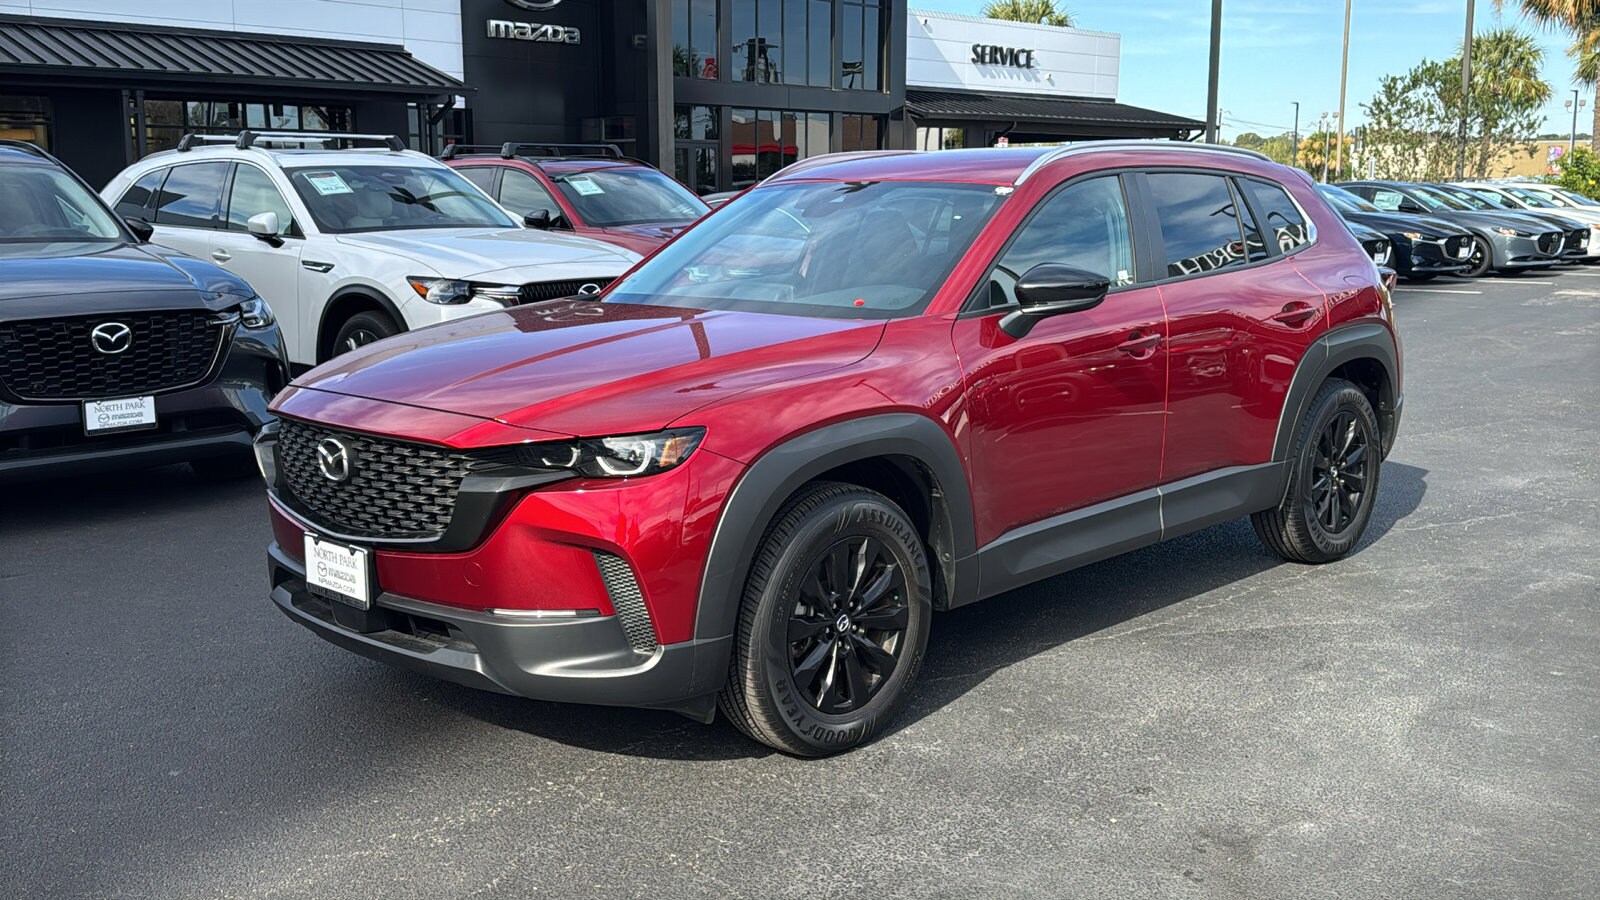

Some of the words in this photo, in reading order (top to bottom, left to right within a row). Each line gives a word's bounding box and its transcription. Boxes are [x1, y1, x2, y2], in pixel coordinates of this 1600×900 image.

[971, 43, 1035, 69] SERVICE
[94, 403, 123, 413] NORTH
[125, 401, 146, 410] PARK
[857, 507, 928, 577] ASSURANCE
[313, 547, 338, 564] NORTH
[339, 554, 358, 570] PARK
[318, 577, 356, 594] NPMAZDA.COM
